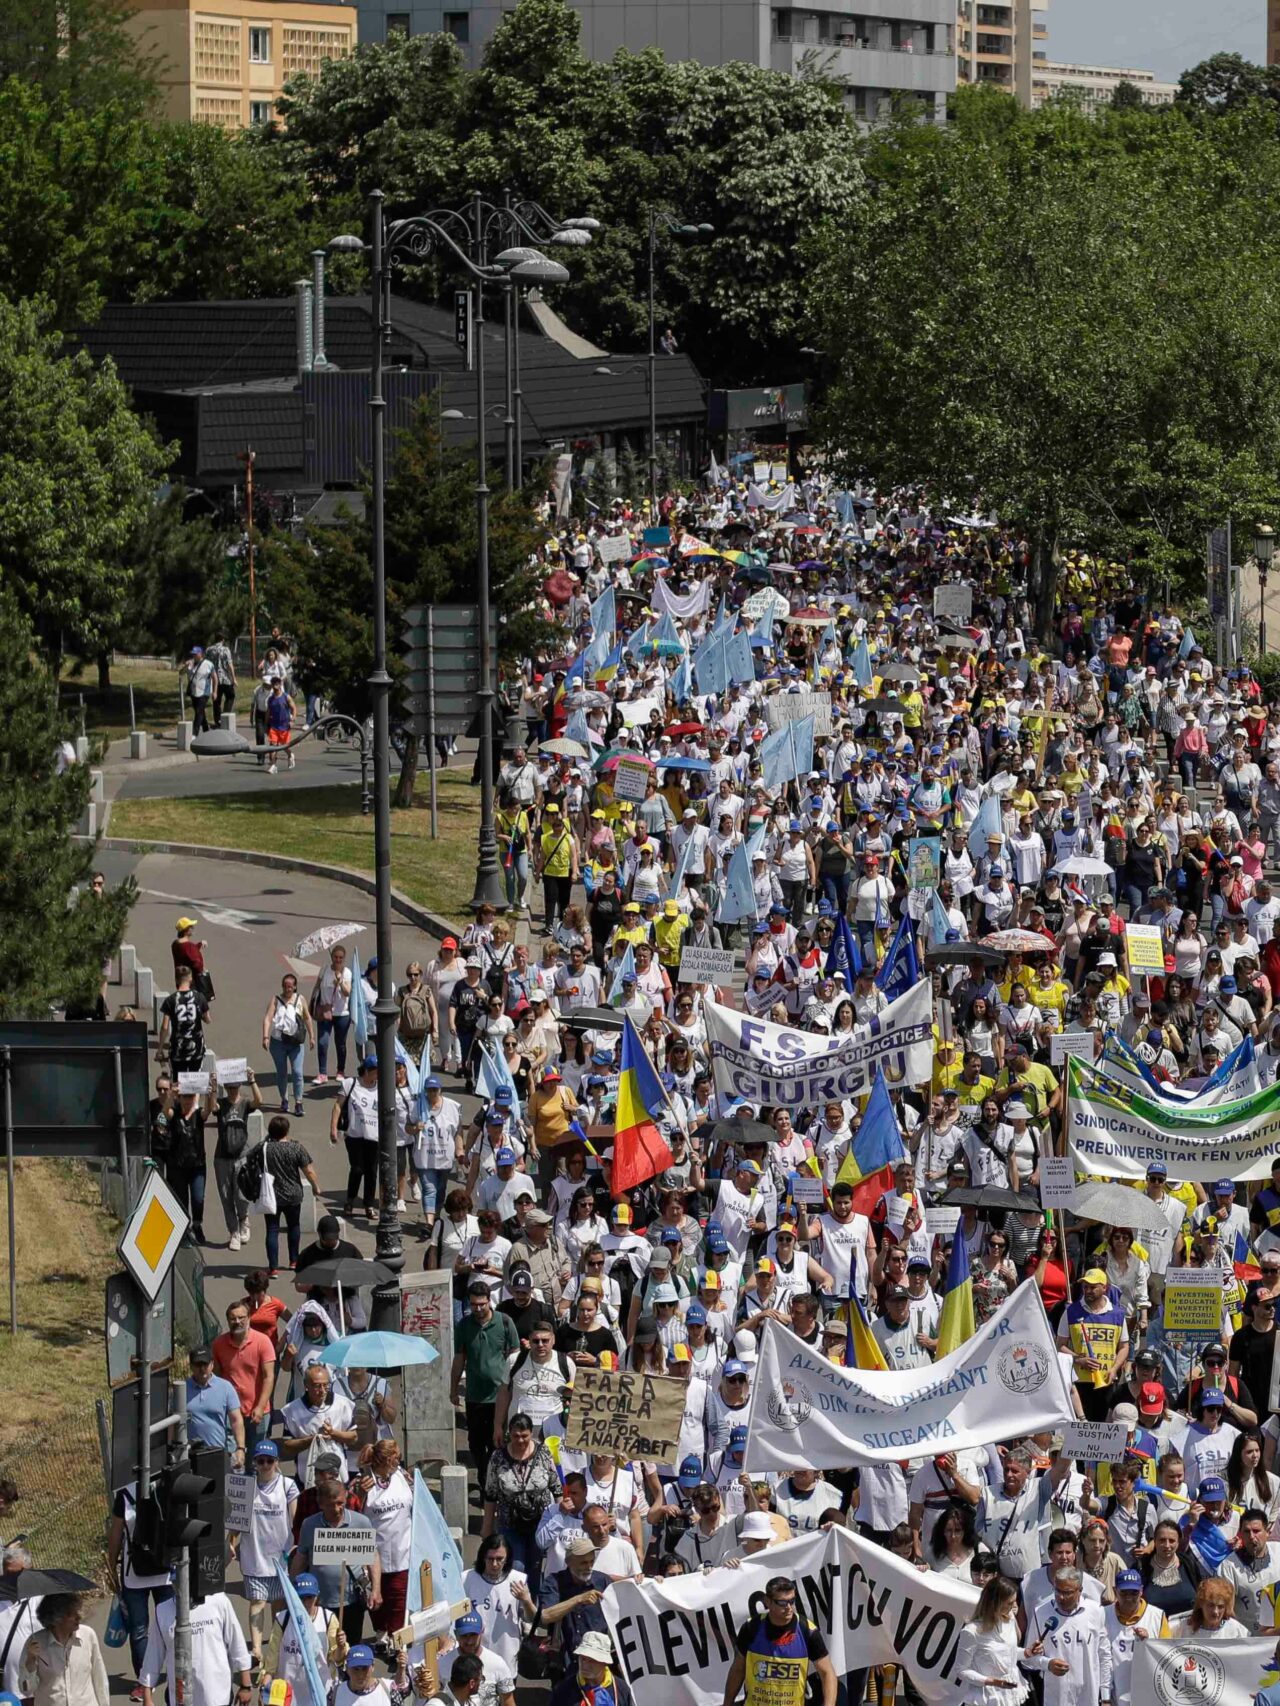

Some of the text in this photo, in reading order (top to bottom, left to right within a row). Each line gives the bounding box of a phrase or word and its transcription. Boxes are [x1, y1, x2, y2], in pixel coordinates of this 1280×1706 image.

[176, 1004, 197, 1021] 23
[712, 1043, 745, 1066] LIGA
[845, 1026, 924, 1064] DIDACTICE
[1074, 1113, 1170, 1144] SINDICATULUI
[1201, 1150, 1231, 1161] FEN
[1088, 1329, 1115, 1342] FSE
[818, 1392, 848, 1413] DIN
[580, 1418, 641, 1438] POPOR
[863, 1418, 957, 1449] SUCEAVA
[1070, 1422, 1101, 1430] ELEVII
[576, 1431, 670, 1457] ANALFABET
[318, 1530, 326, 1539] ÎN
[314, 1545, 335, 1553] LEGEA
[336, 1545, 351, 1553] NU-I
[1123, 1575, 1139, 1583] FSLI
[847, 1562, 893, 1633] CU
[1050, 1630, 1093, 1651] FSLI
[766, 1662, 800, 1680] FSE
[754, 1686, 795, 1698] Sindicatul
